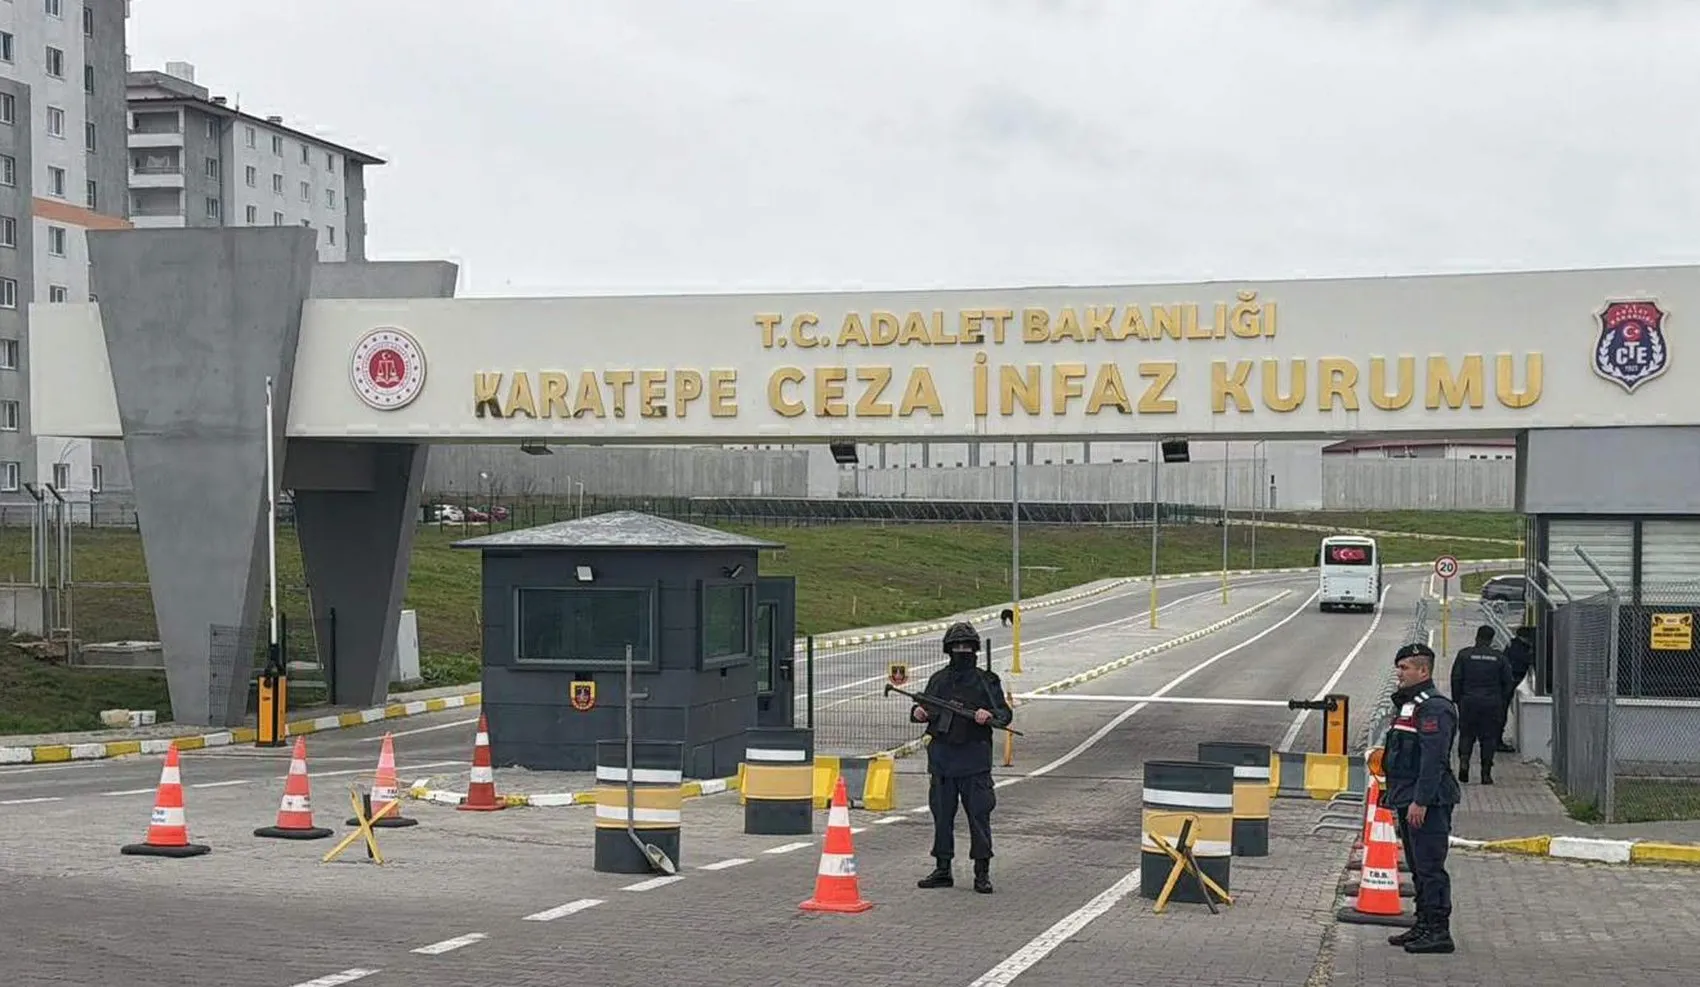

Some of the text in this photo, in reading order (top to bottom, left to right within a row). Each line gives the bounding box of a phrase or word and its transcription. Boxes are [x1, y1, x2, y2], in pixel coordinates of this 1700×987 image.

[1022, 289, 1277, 343] BAKANLIĞI
[1615, 341, 1648, 365] CTE
[473, 351, 1544, 418] KARATEPE CEZA İNFAZ KURUMU
[1440, 562, 1454, 572] 20
